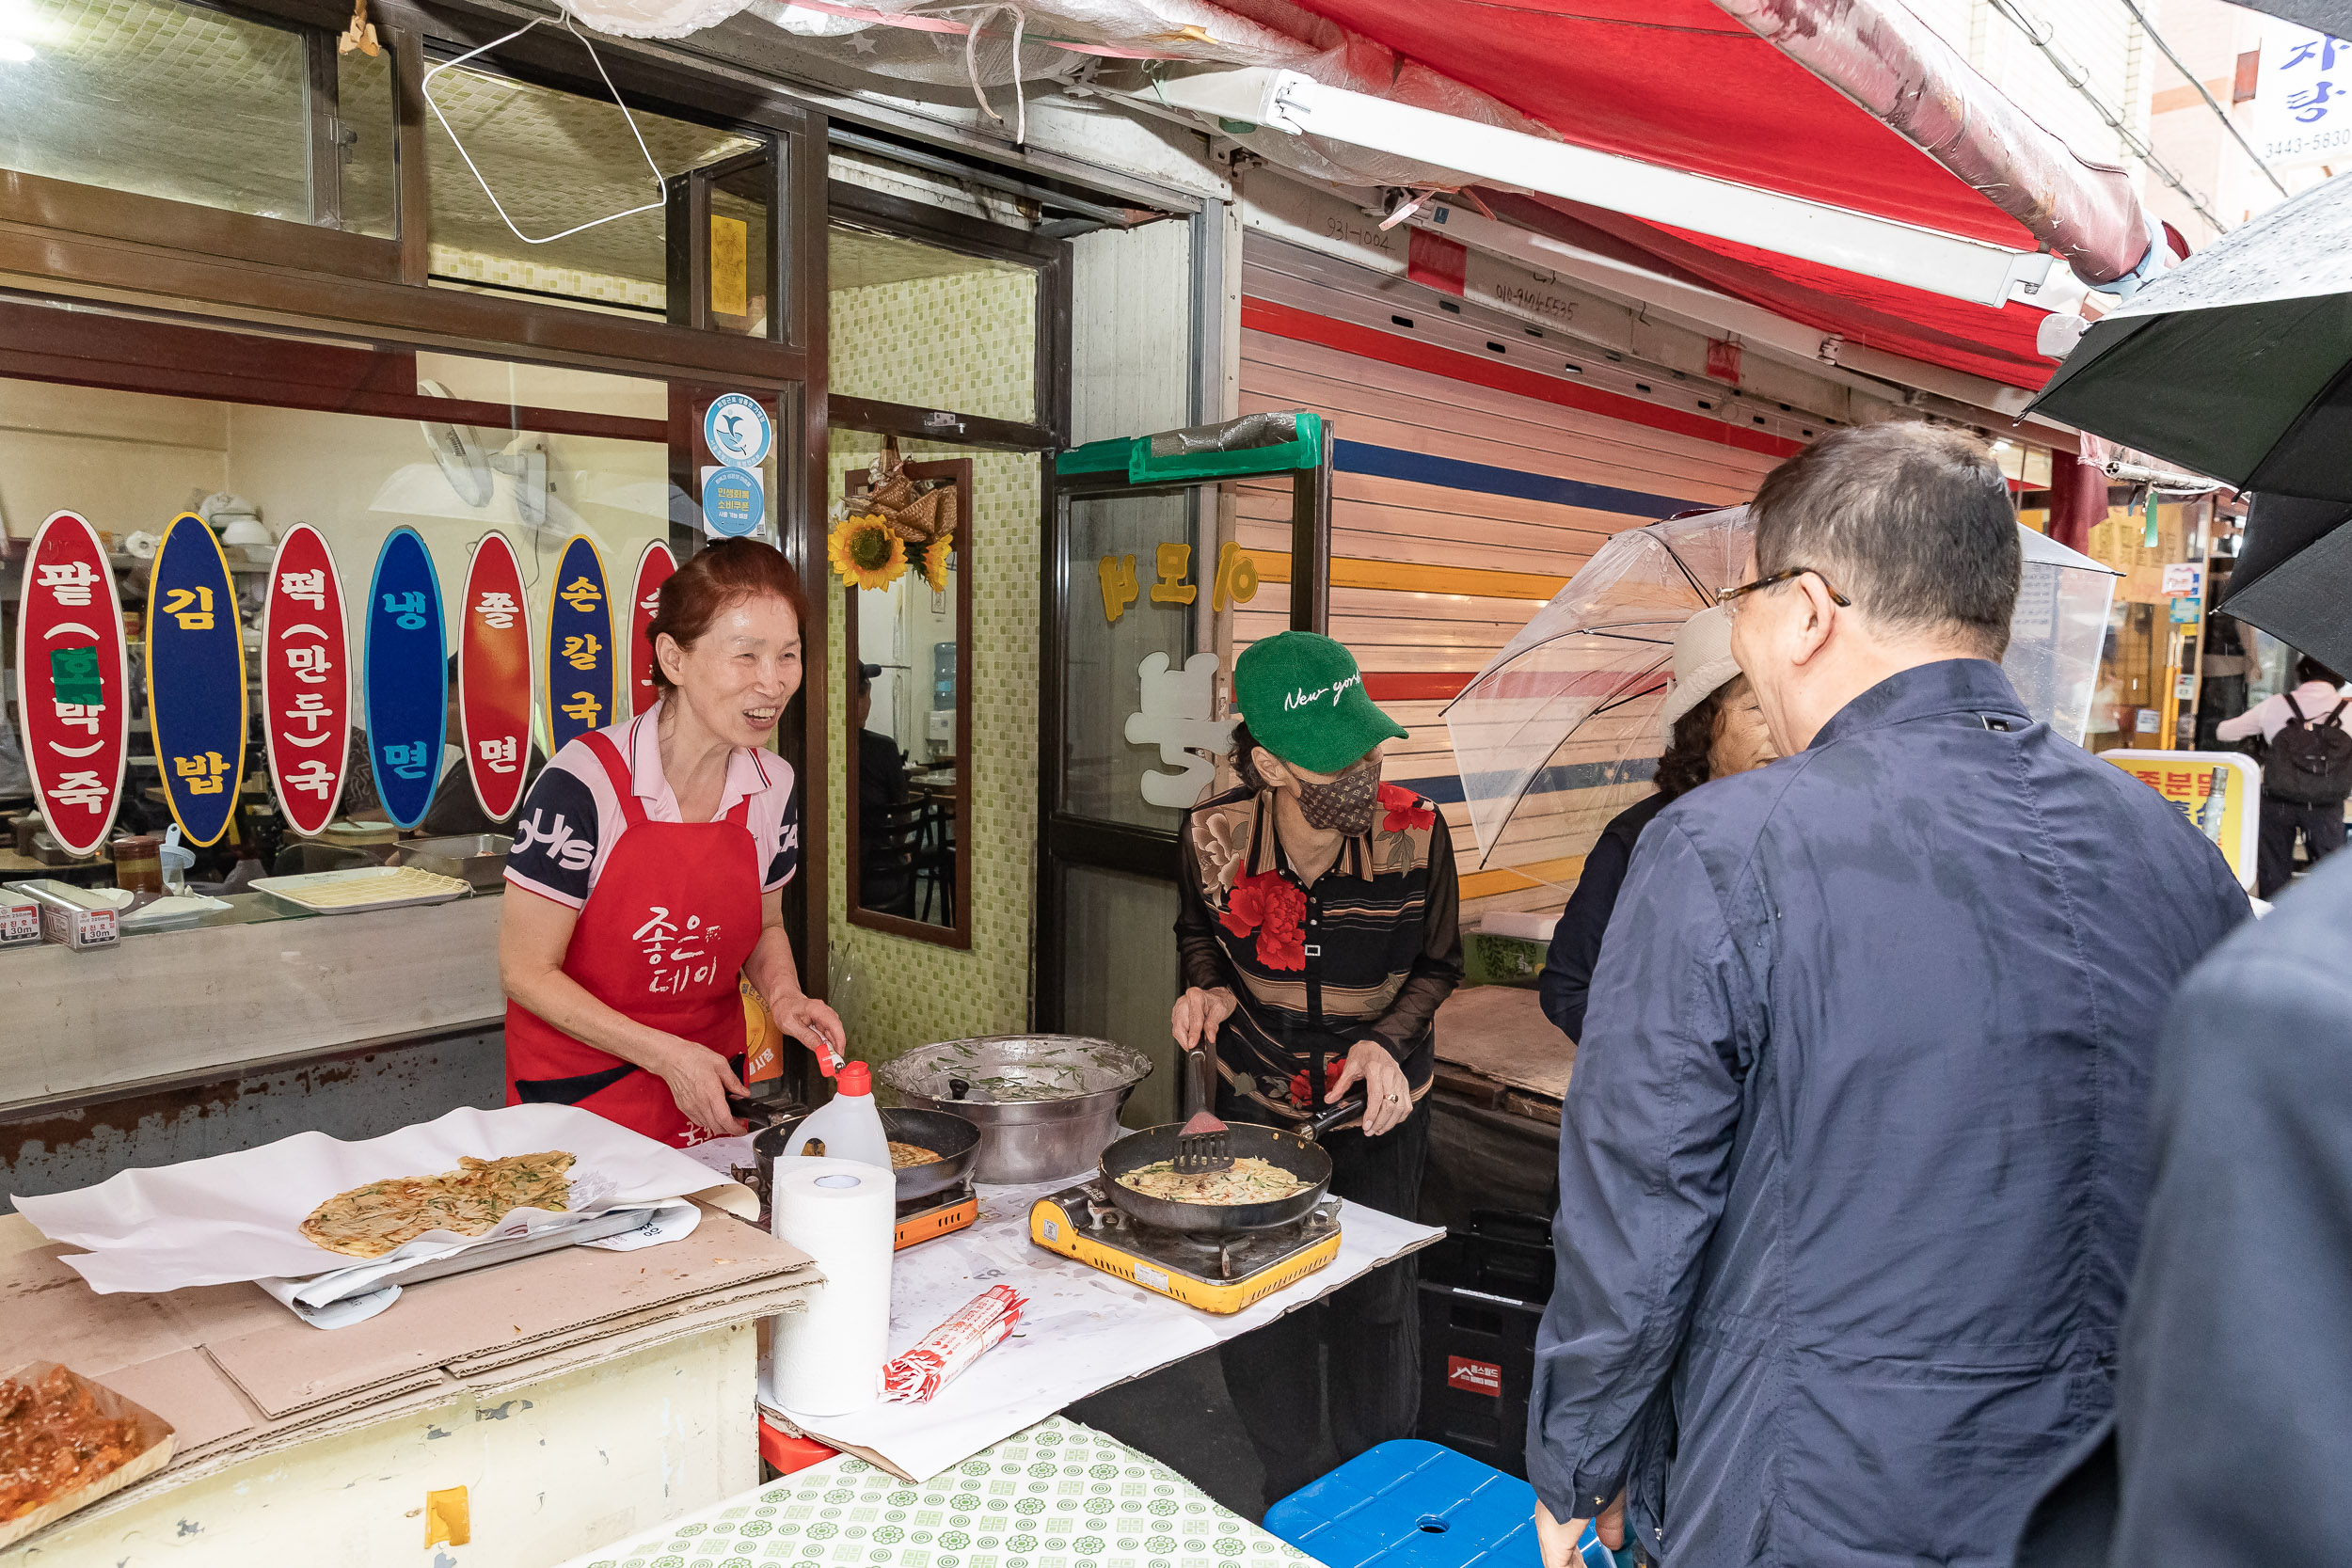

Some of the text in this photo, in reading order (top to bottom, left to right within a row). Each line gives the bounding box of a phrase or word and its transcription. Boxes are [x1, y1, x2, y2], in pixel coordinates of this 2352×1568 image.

[2265, 129, 2350, 158] 3443-5830
[718, 487, 750, 499] 민생회복
[718, 500, 750, 512] 소비쿠폰
[163, 586, 230, 795] 김밥
[382, 591, 427, 779] 냉면
[474, 592, 519, 772] 쫄면
[1284, 688, 1329, 711] New
[632, 907, 705, 964] 좋은
[649, 956, 716, 994] 데이
